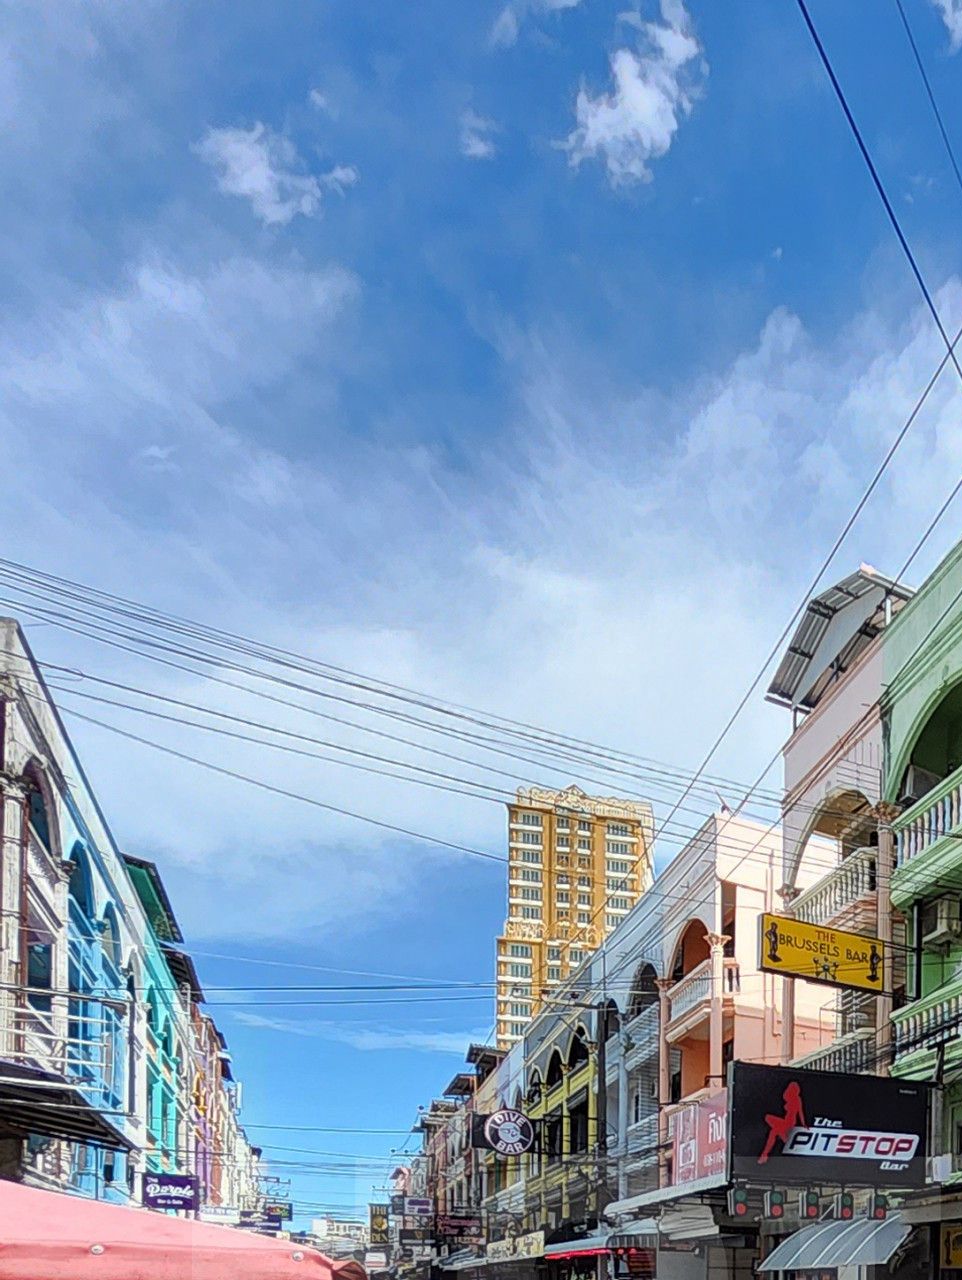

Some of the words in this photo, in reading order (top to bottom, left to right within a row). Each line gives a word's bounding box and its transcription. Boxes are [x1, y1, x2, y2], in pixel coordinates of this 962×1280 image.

[816, 930, 836, 943] THE
[779, 933, 840, 957] BRUSSELS
[846, 949, 869, 963] BAR
[493, 1112, 526, 1127] DIVE
[496, 1140, 525, 1153] BAR
[789, 1131, 913, 1156] PITSTOP
[371, 1233, 388, 1242] DEN
